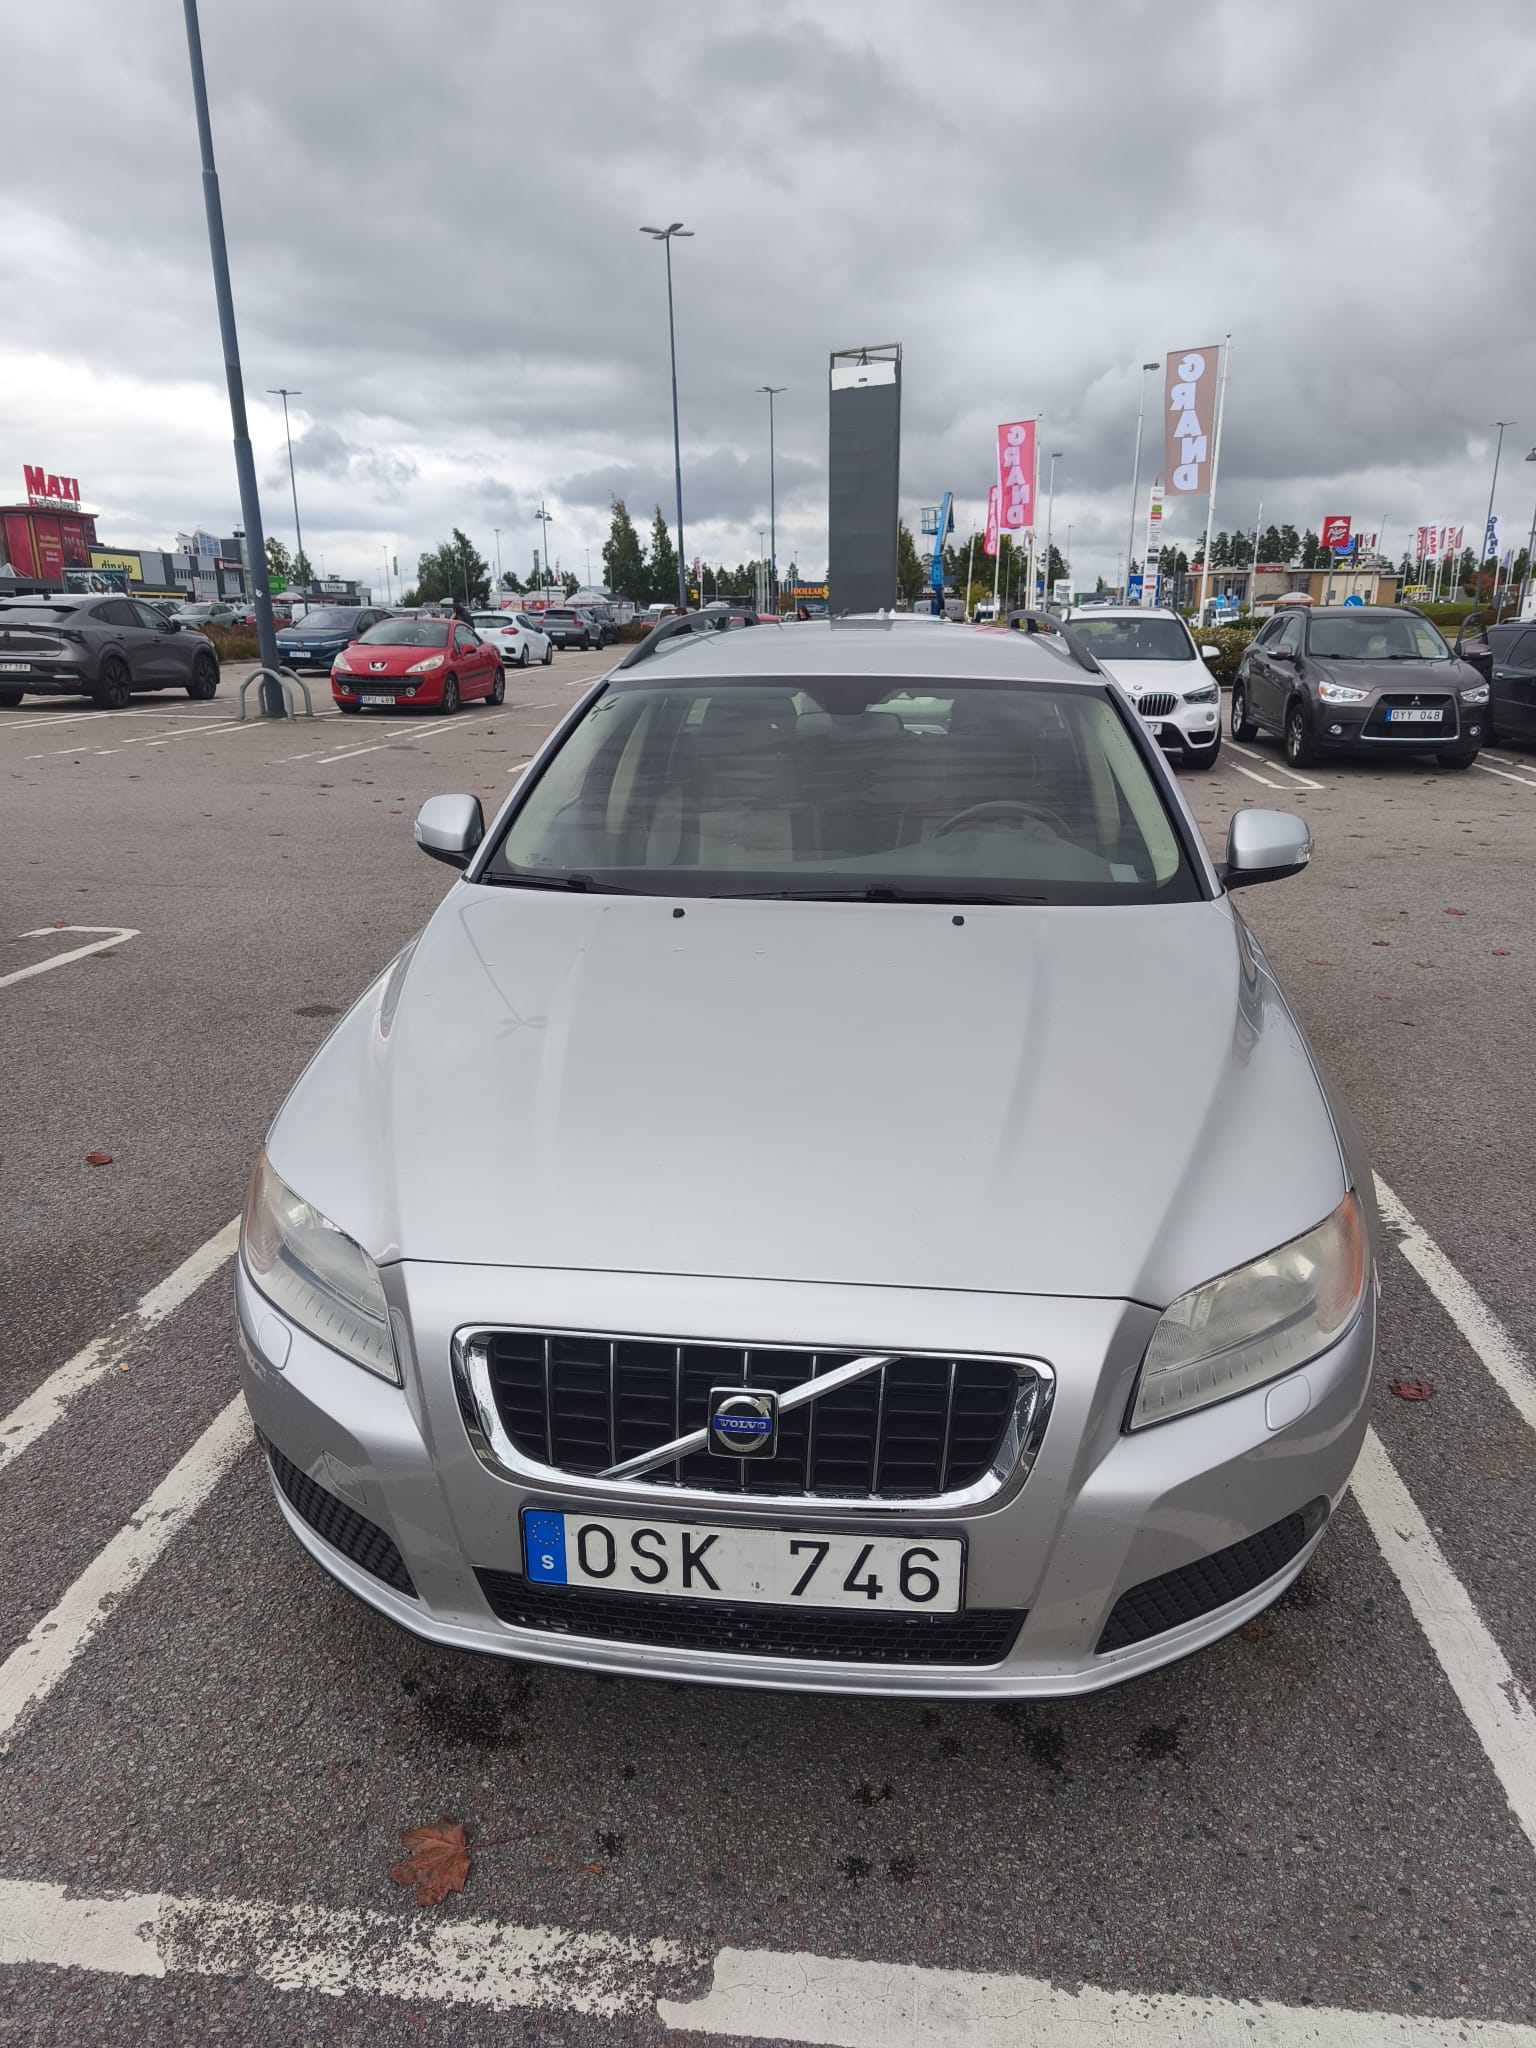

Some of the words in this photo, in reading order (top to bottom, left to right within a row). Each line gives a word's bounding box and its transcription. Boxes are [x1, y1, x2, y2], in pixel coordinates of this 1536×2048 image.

[24, 465, 80, 501] MAXI
[1392, 711, 1412, 720] OYY
[1420, 711, 1440, 720] 048
[718, 1418, 767, 1430] VOLVO
[541, 1554, 555, 1570] S
[576, 1523, 721, 1592] OSK
[789, 1539, 941, 1603] 746
